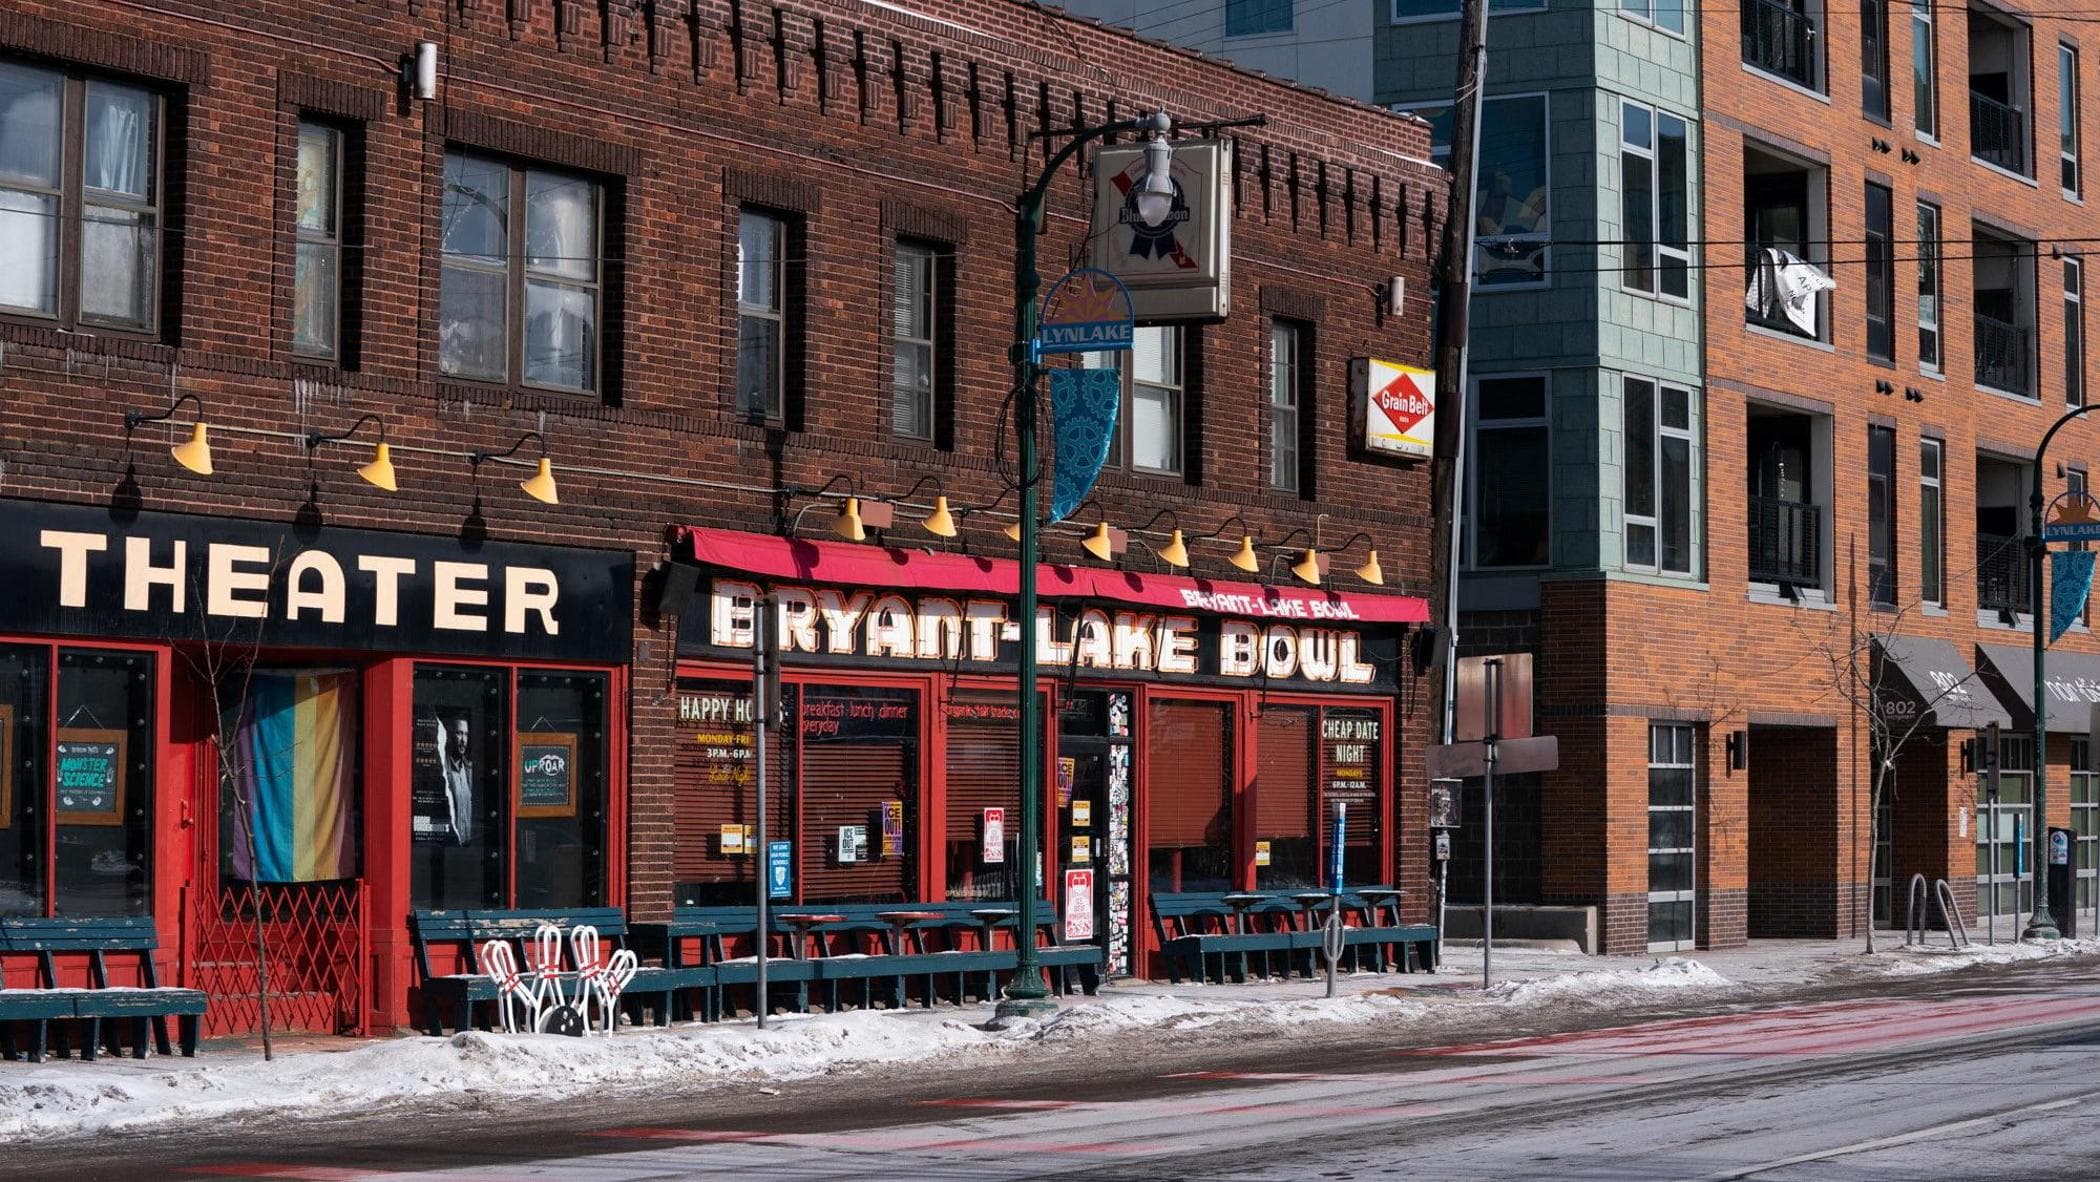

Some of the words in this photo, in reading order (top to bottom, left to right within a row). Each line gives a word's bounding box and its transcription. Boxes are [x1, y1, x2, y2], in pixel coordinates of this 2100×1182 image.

[1042, 324, 1131, 344] LYNLAKE
[1381, 389, 1409, 413] Grain
[1408, 394, 1429, 416] Belt
[40, 529, 560, 636] THEATER
[1180, 589, 1308, 618] BRYANT-LAKE
[1309, 600, 1360, 619] BOWL
[710, 577, 1200, 674] BRYANT-LAKE
[1220, 619, 1377, 685] BOWL
[1930, 671, 1968, 695] 802
[680, 696, 730, 721] HAPPY
[1886, 701, 1916, 715] 802
[802, 718, 840, 736] veryday
[1322, 719, 1353, 739] CHEAP
[1356, 721, 1379, 740] DATE
[1336, 744, 1365, 763] NIGHT
[61, 757, 108, 773] MONSTER
[524, 757, 566, 774] UPROAR
[63, 771, 106, 788] SCIENCE
[884, 807, 901, 818] ICE
[843, 838, 854, 849] OUT
